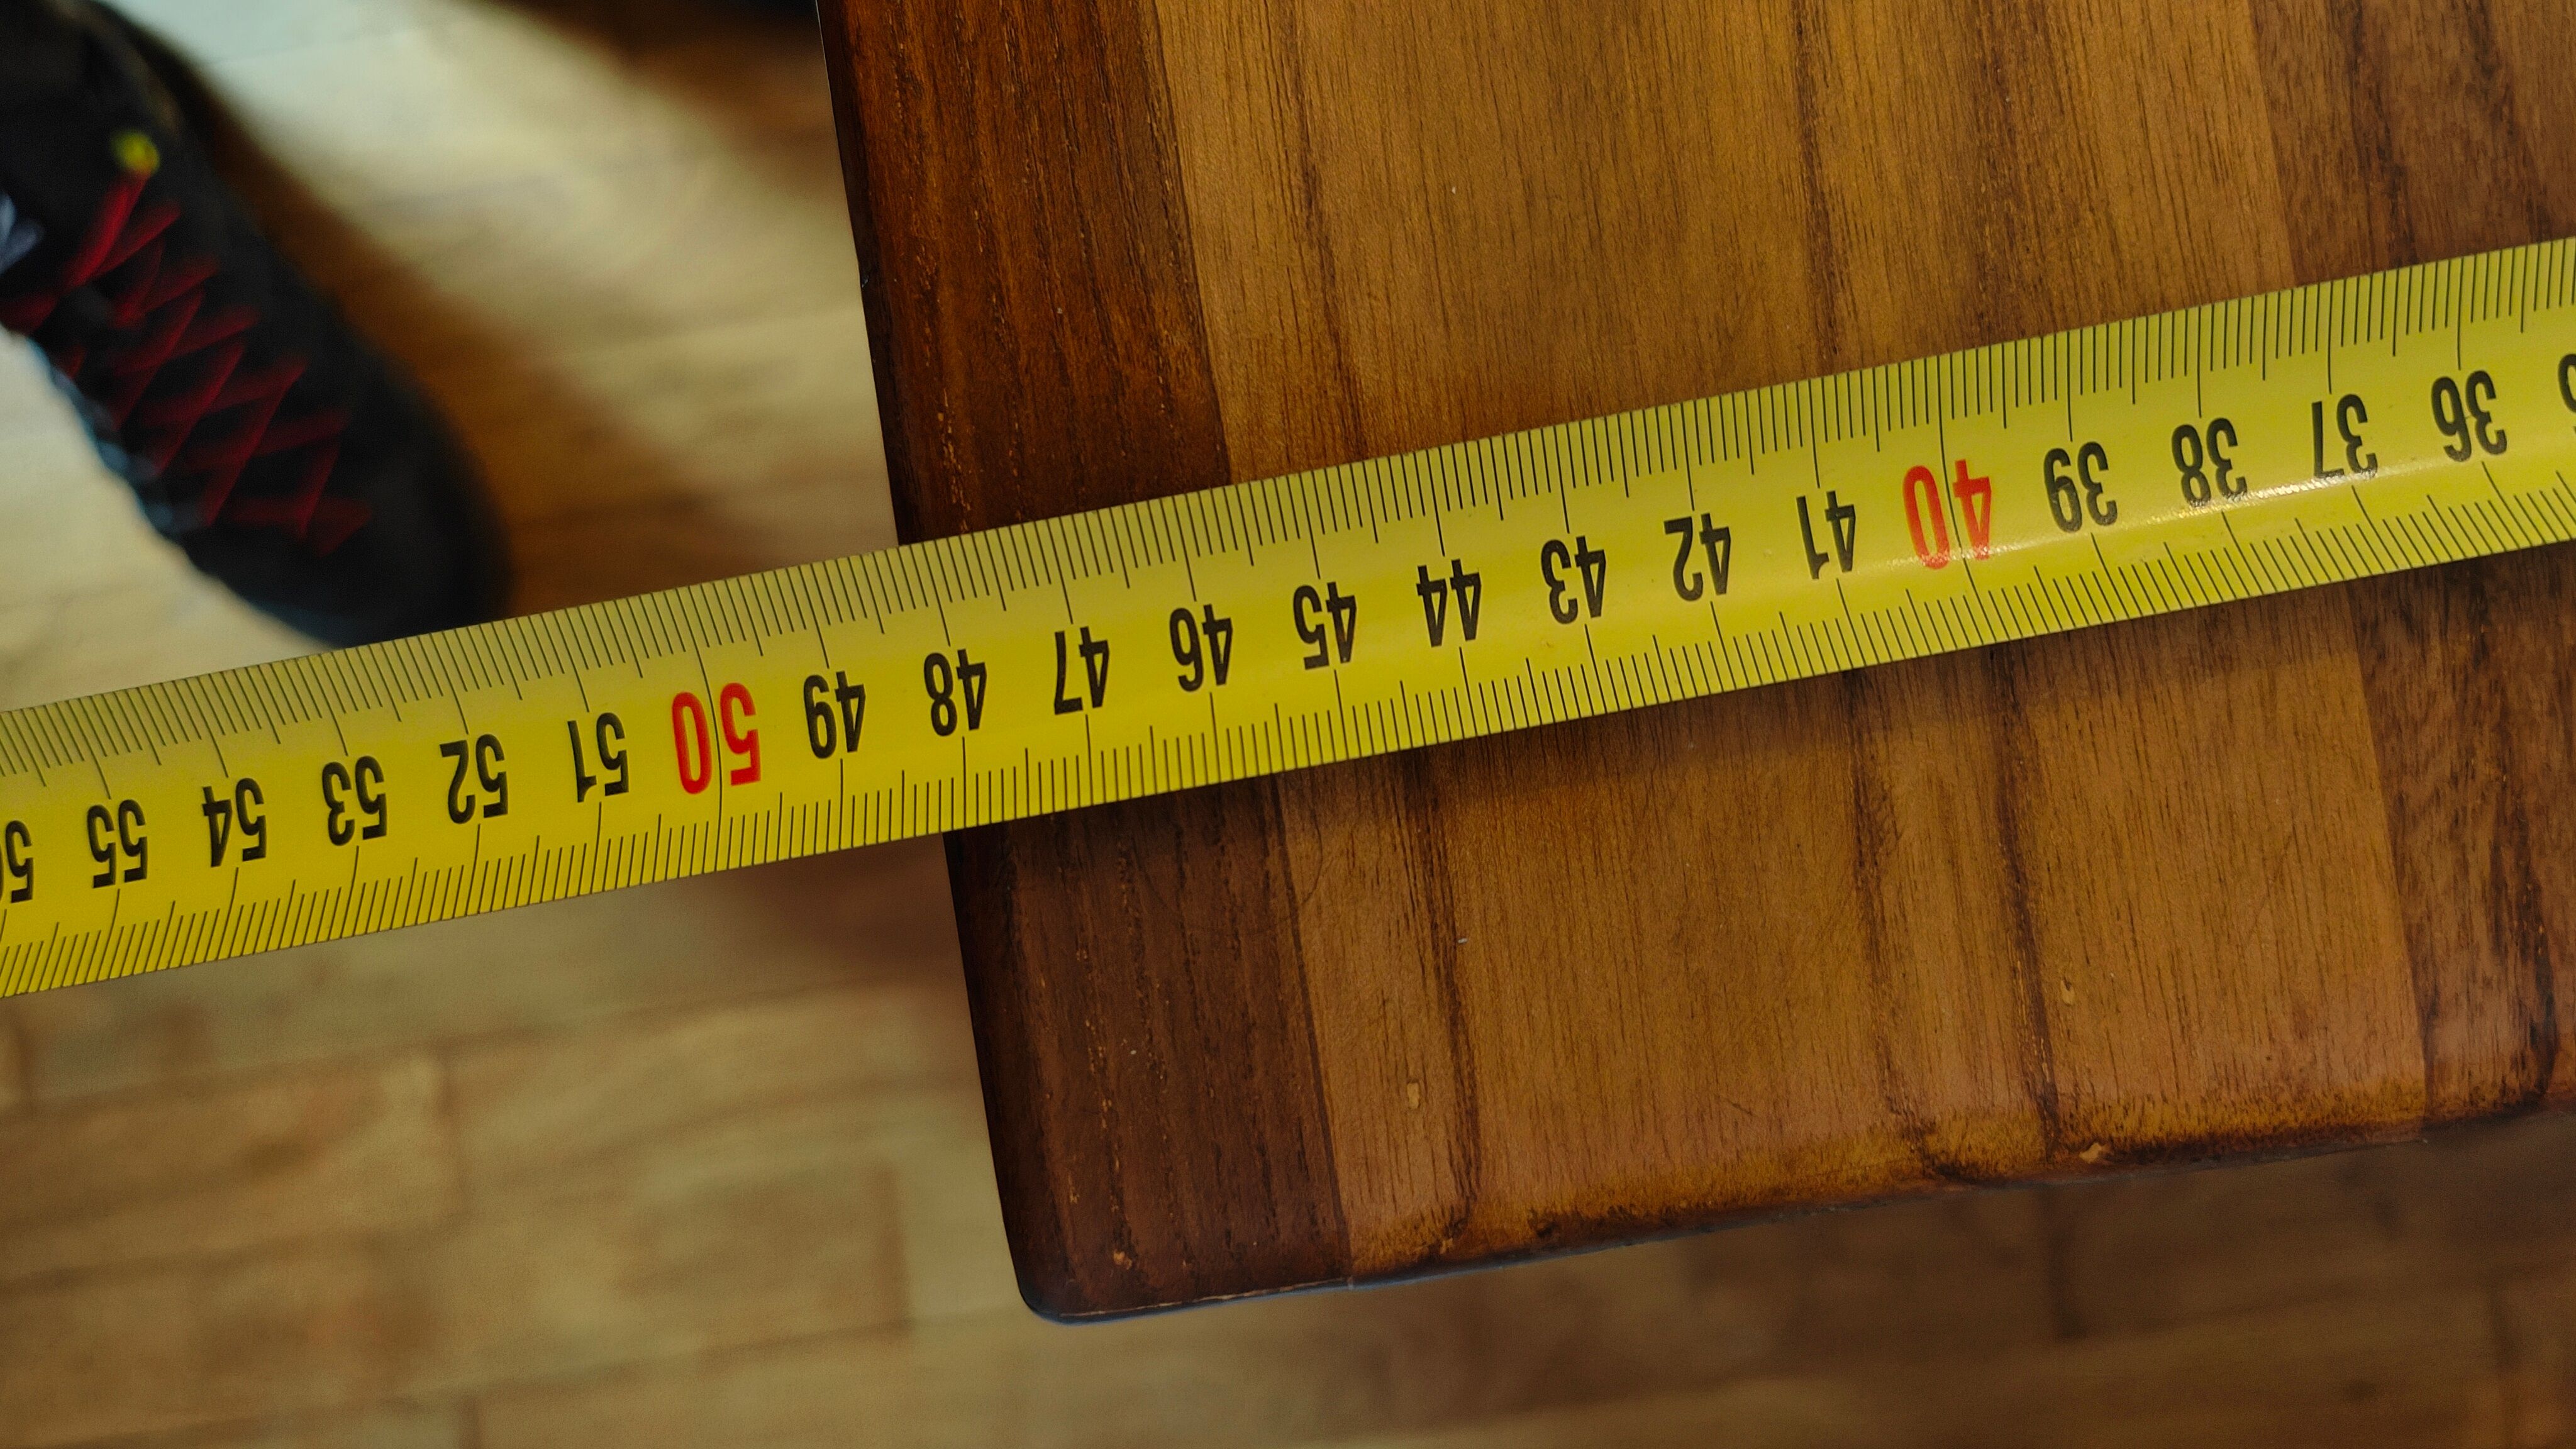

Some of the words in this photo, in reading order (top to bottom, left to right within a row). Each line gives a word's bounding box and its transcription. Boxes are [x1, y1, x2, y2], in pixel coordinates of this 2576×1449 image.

[2311, 393, 2379, 479] 37
[2431, 370, 2507, 462] 36
[2044, 441, 2118, 531] 39
[2171, 417, 2248, 508] 38
[1664, 513, 1731, 601] 42
[1796, 491, 1856, 579] 41
[1902, 458, 1992, 569] 40
[1416, 559, 1481, 647] 44
[1541, 536, 1606, 624] 43
[1054, 626, 1109, 715] 47
[1170, 604, 1233, 692] 46
[1293, 582, 1357, 670] 45
[804, 671, 865, 758] 49
[924, 649, 987, 736] 48
[440, 735, 508, 824] 52
[567, 713, 628, 802] 51
[671, 682, 761, 795] 50
[87, 799, 147, 889] 55
[202, 778, 266, 867] 54
[322, 756, 387, 846] 53
[0, 821, 33, 904] 5
